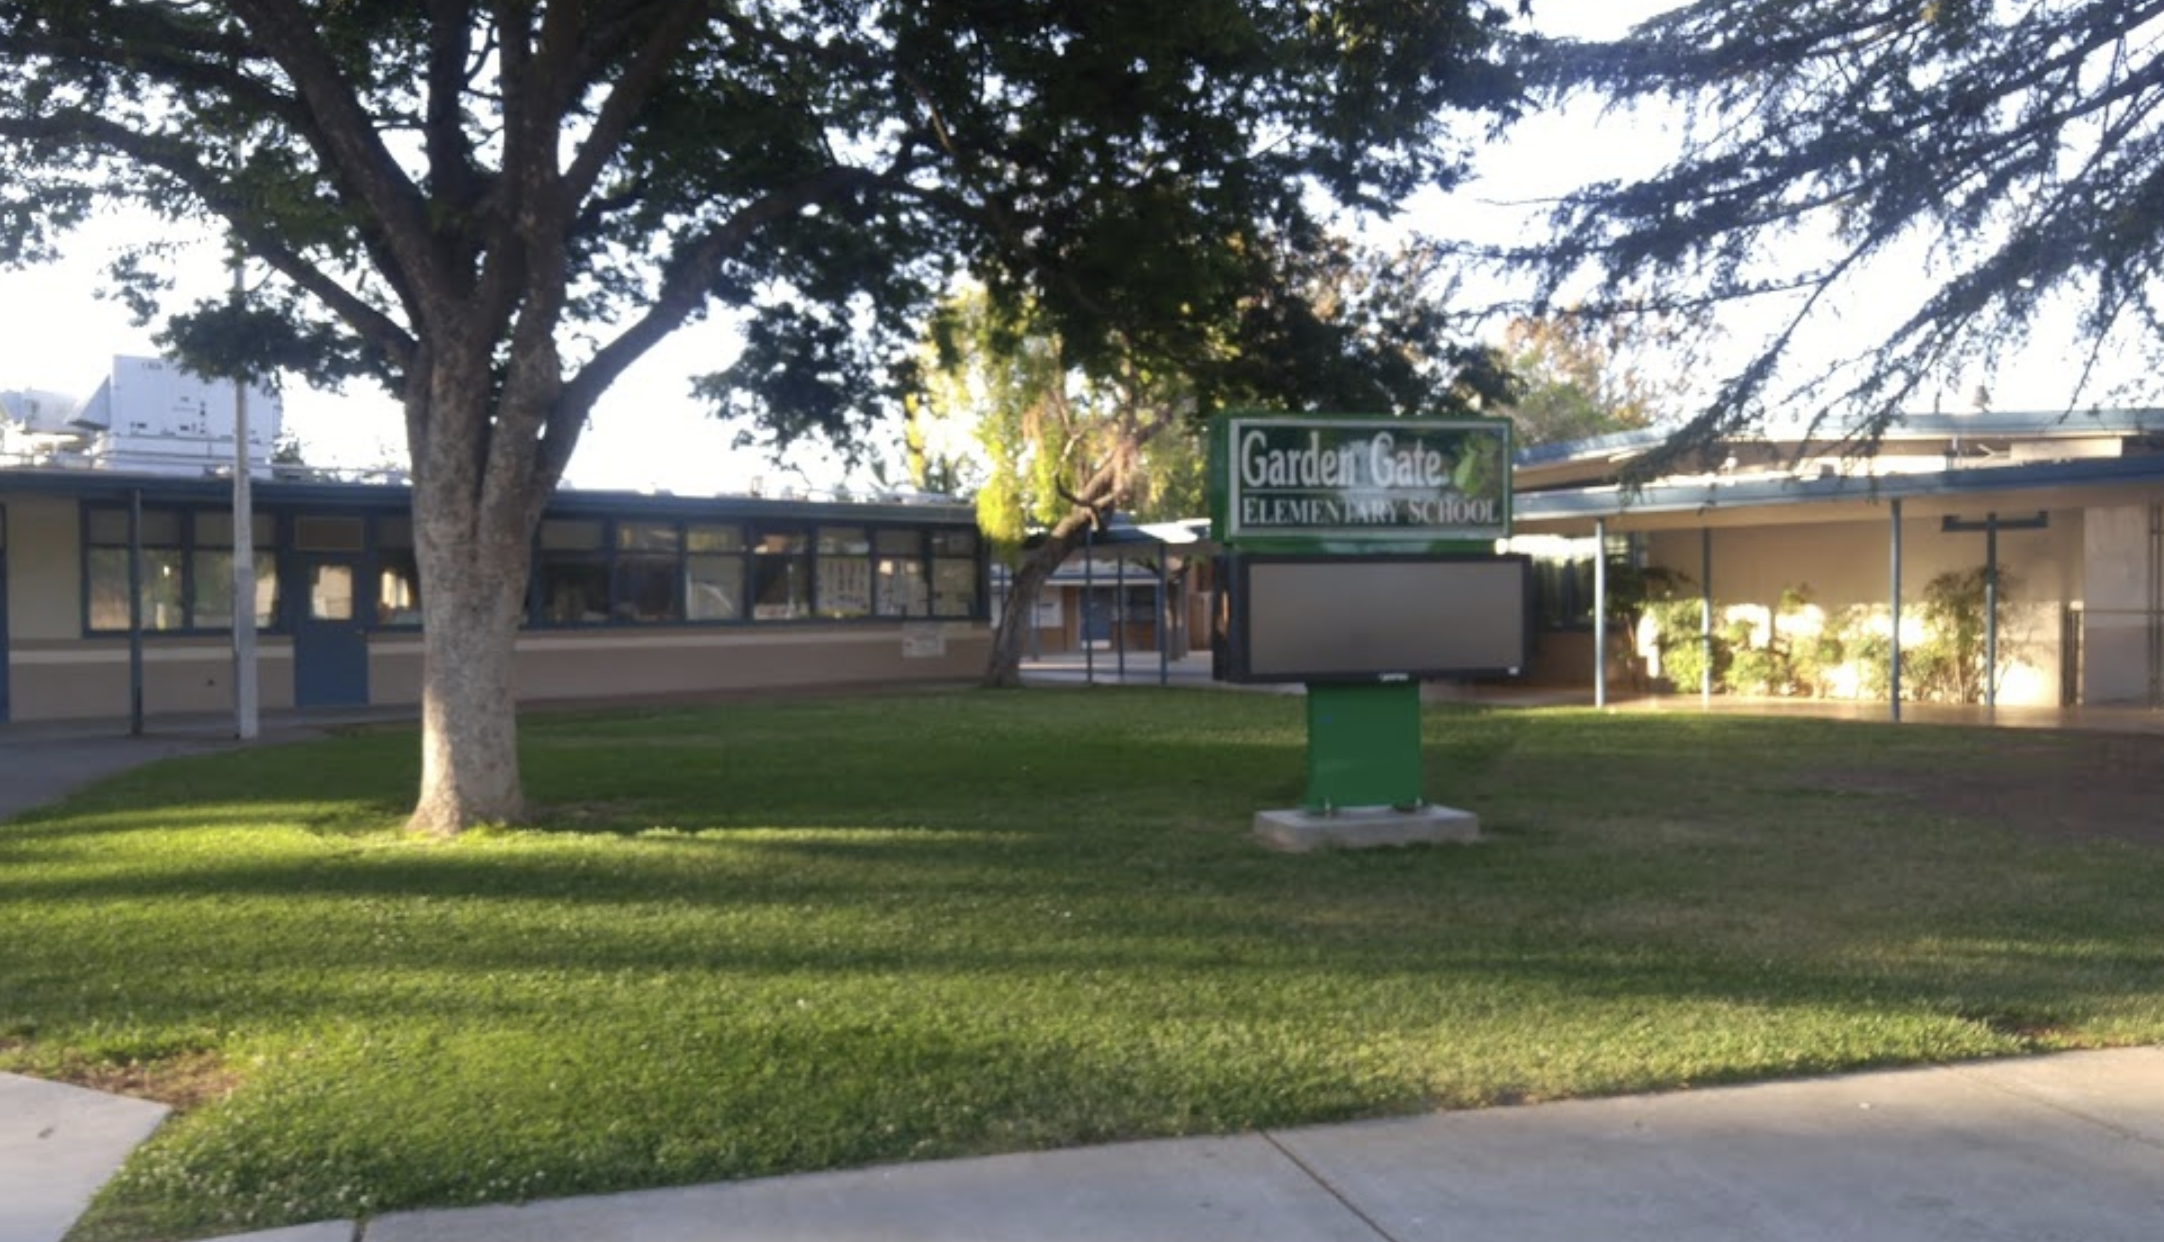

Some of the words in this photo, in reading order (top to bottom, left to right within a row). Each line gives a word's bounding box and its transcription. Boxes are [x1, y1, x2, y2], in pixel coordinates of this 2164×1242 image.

[1241, 430, 1355, 487] Garden
[1369, 431, 1443, 487] Gate
[1243, 498, 1398, 524] ELEMENTARY
[1407, 499, 1500, 524] SCHOOL
